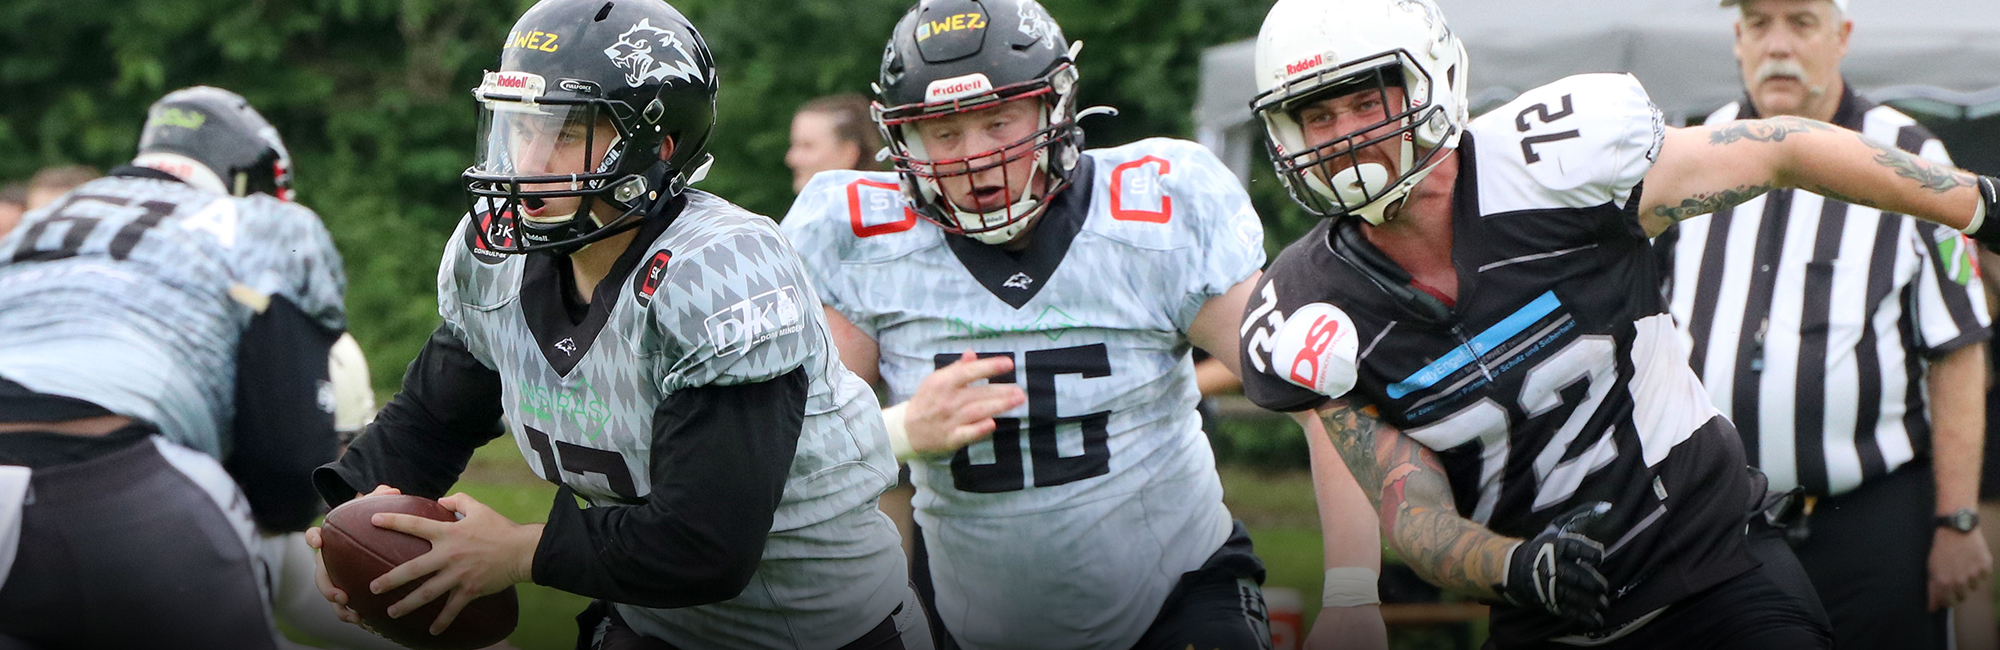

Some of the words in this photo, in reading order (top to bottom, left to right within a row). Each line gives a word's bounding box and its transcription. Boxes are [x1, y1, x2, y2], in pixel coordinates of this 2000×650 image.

[513, 31, 559, 53] WEZ
[931, 13, 987, 35] WEZ
[497, 74, 529, 88] Riddell
[1286, 54, 1323, 76] Riddell
[1515, 93, 1581, 165] 72
[11, 195, 178, 261] 61
[715, 299, 775, 357] DJK
[760, 331, 779, 343] DOM
[1240, 278, 1285, 374] 72
[1289, 314, 1339, 390] DS
[1524, 344, 1540, 358] und
[1403, 334, 1619, 528] 72
